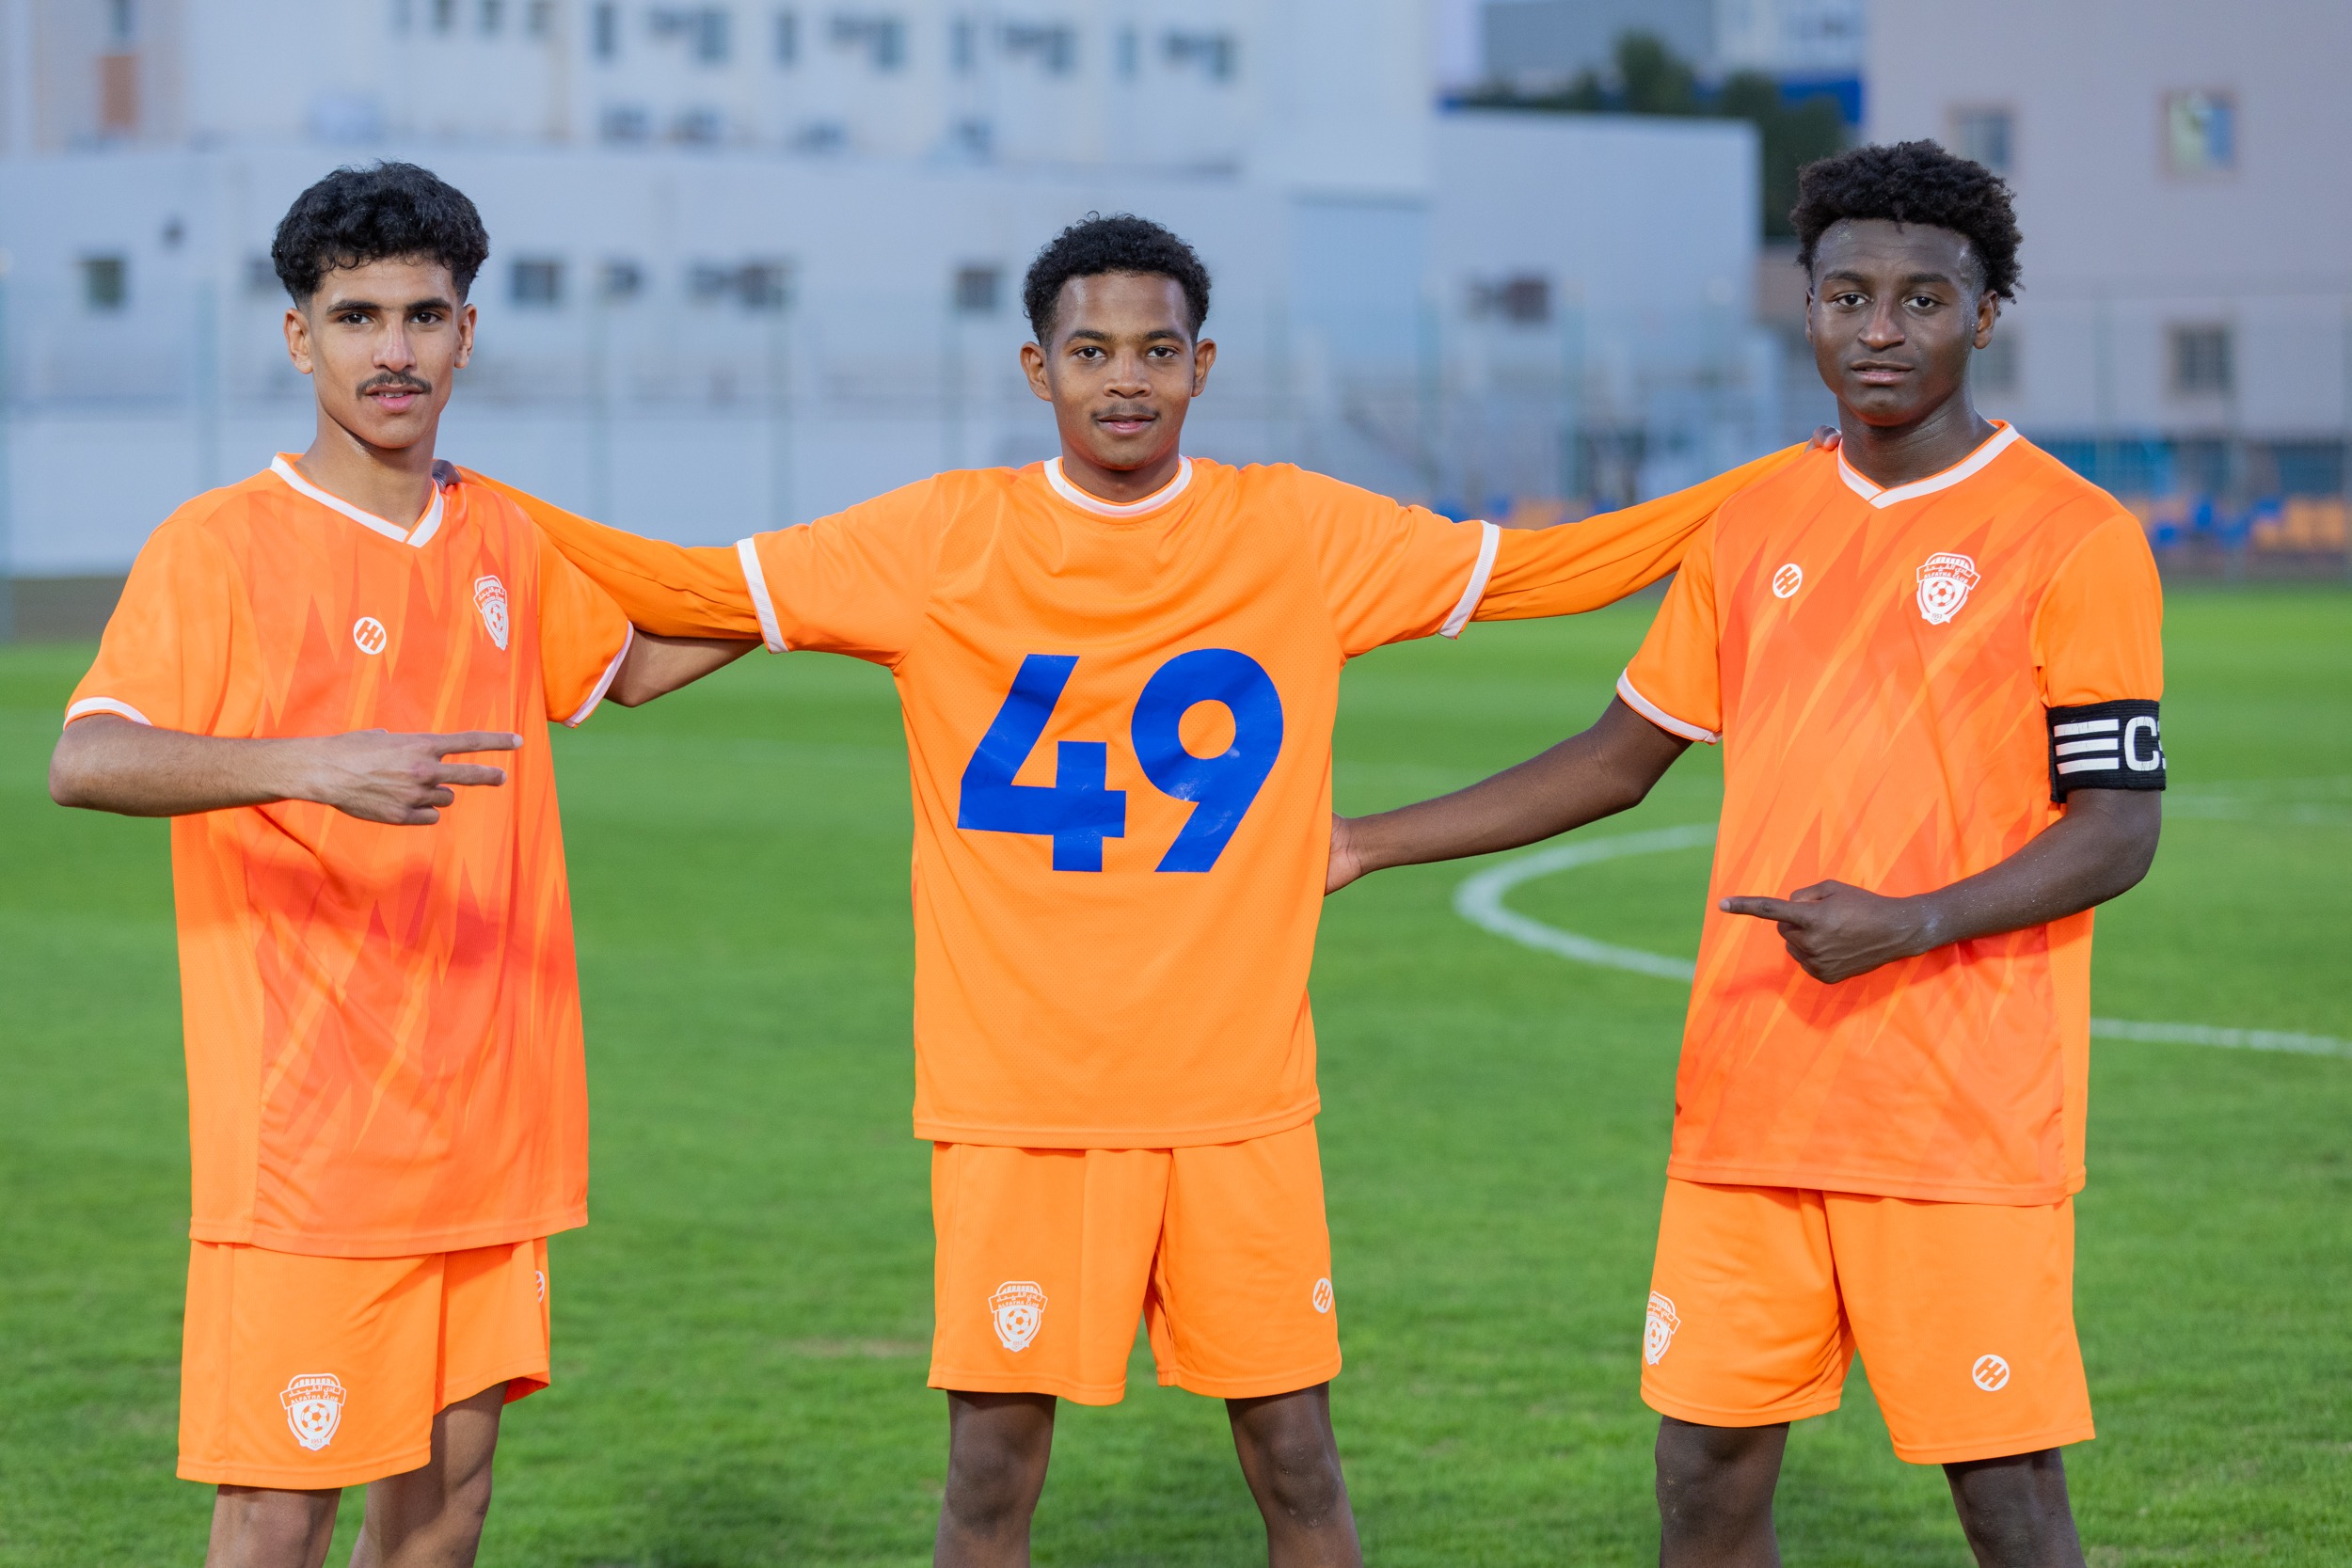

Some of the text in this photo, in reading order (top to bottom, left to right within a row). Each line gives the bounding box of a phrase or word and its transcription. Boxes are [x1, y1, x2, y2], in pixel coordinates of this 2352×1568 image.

[1952, 573, 1969, 584] CLUB
[957, 648, 1284, 873] 49
[291, 1394, 339, 1404] ALFAYHA CLUB
